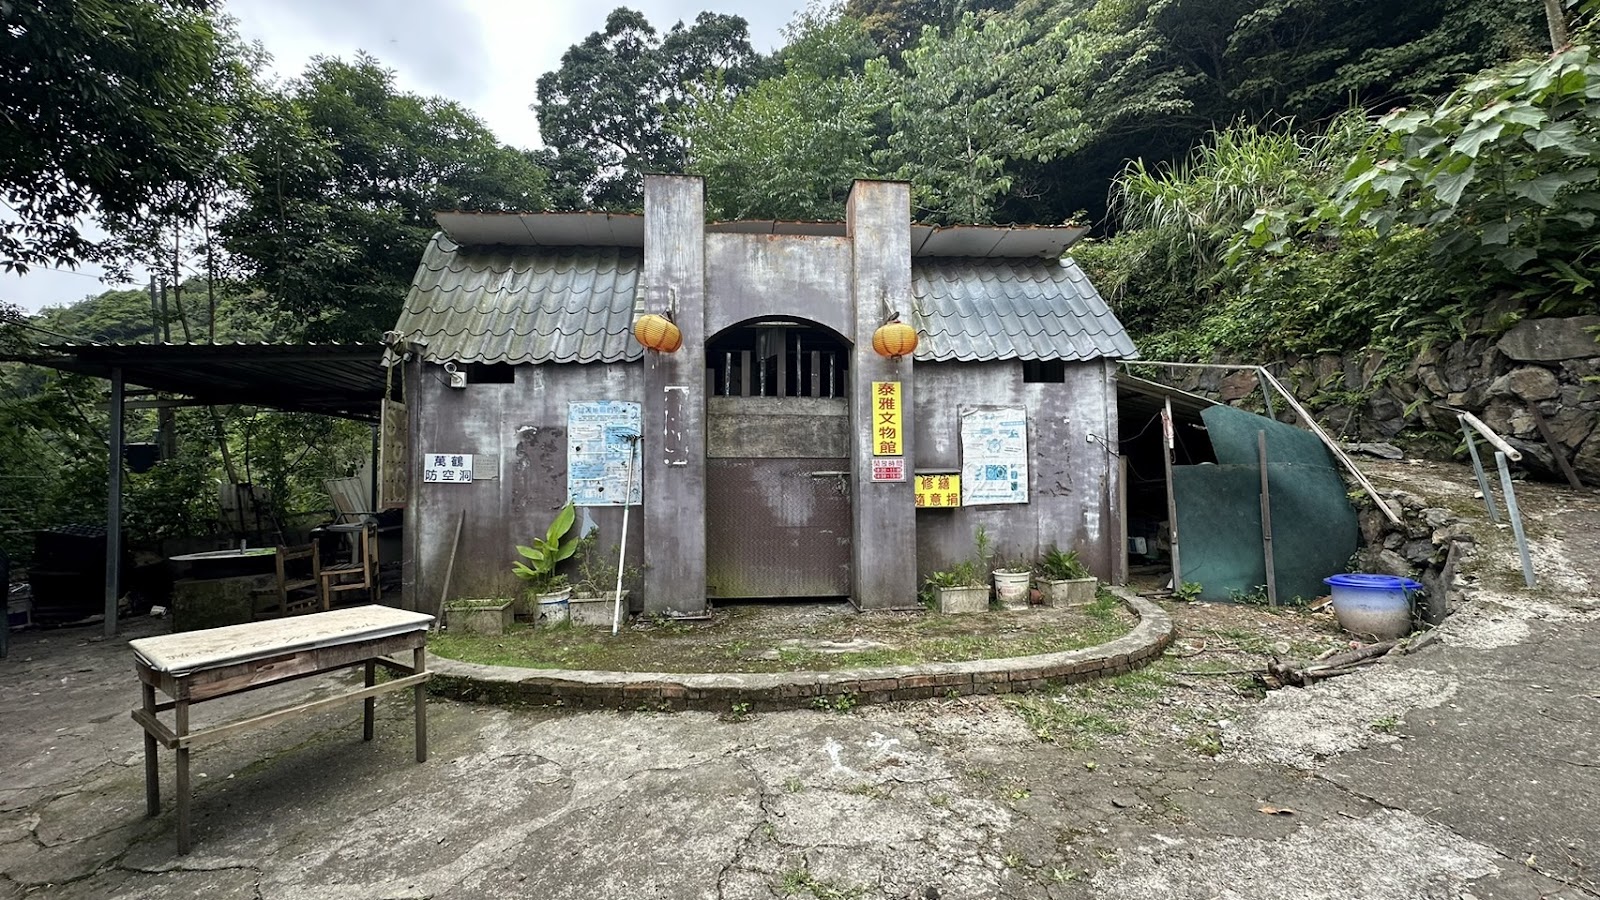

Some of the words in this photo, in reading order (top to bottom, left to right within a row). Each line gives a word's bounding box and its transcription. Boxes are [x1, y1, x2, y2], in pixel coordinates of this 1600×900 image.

[878, 383, 896, 454] 泰雅文物館
[434, 456, 464, 467] 萬鶴
[425, 469, 472, 481] 防空洞
[915, 493, 958, 506] 隨意捐
